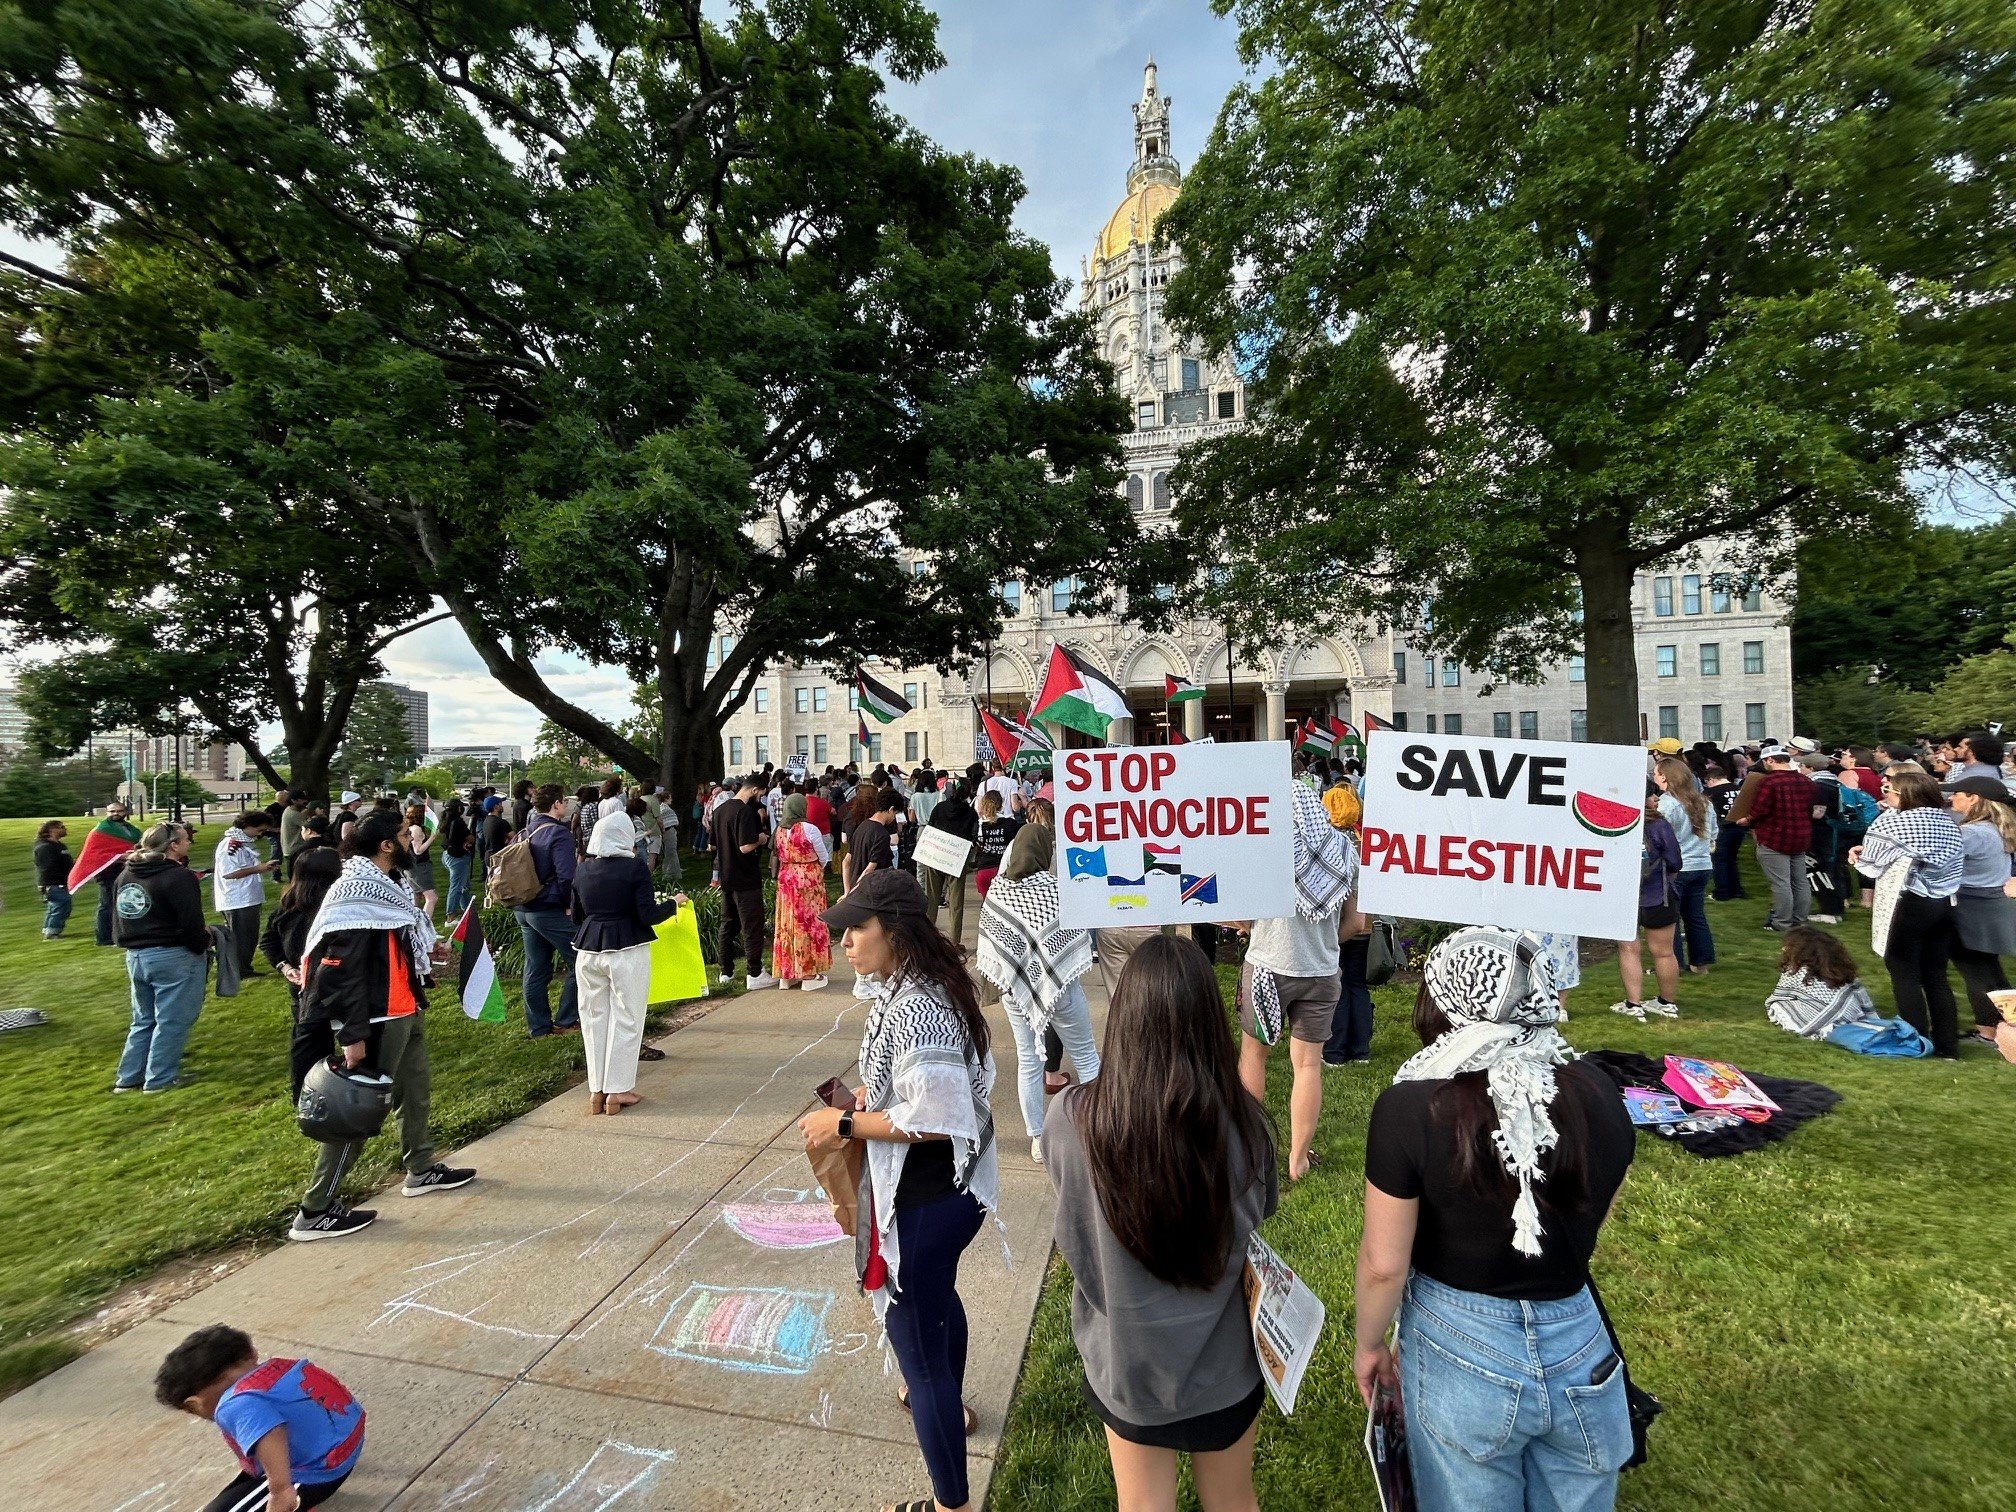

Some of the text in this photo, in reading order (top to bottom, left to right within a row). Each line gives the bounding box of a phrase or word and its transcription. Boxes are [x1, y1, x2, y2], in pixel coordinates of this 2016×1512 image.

[789, 756, 807, 764] FREE
[976, 751, 995, 760] NOW
[1065, 752, 1176, 793] STOP
[1396, 744, 1568, 807] SAVE
[1063, 796, 1270, 843] GENOCIDE
[1360, 827, 1604, 892] PALESTINE
